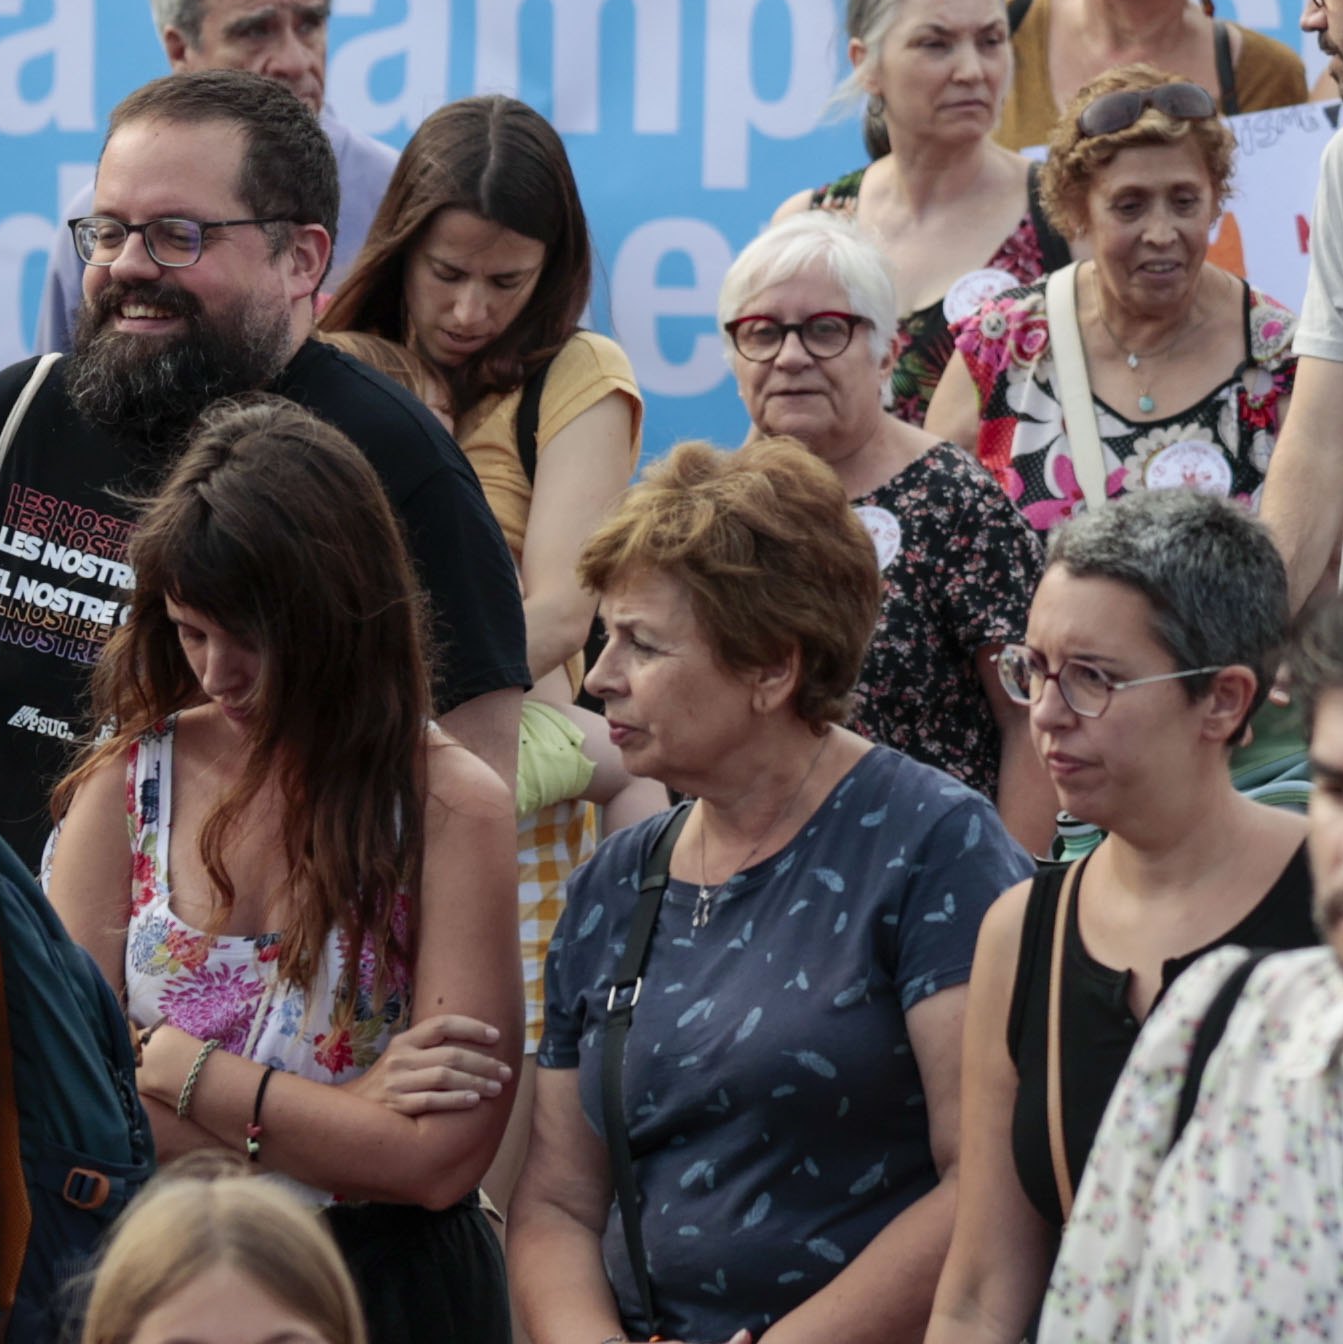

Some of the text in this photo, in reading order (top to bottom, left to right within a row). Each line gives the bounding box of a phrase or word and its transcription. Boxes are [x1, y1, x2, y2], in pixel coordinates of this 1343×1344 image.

[3, 505, 50, 540] LES
[9, 483, 57, 519] LES
[40, 541, 137, 591] NOSTR
[13, 576, 119, 626] NOSTRE
